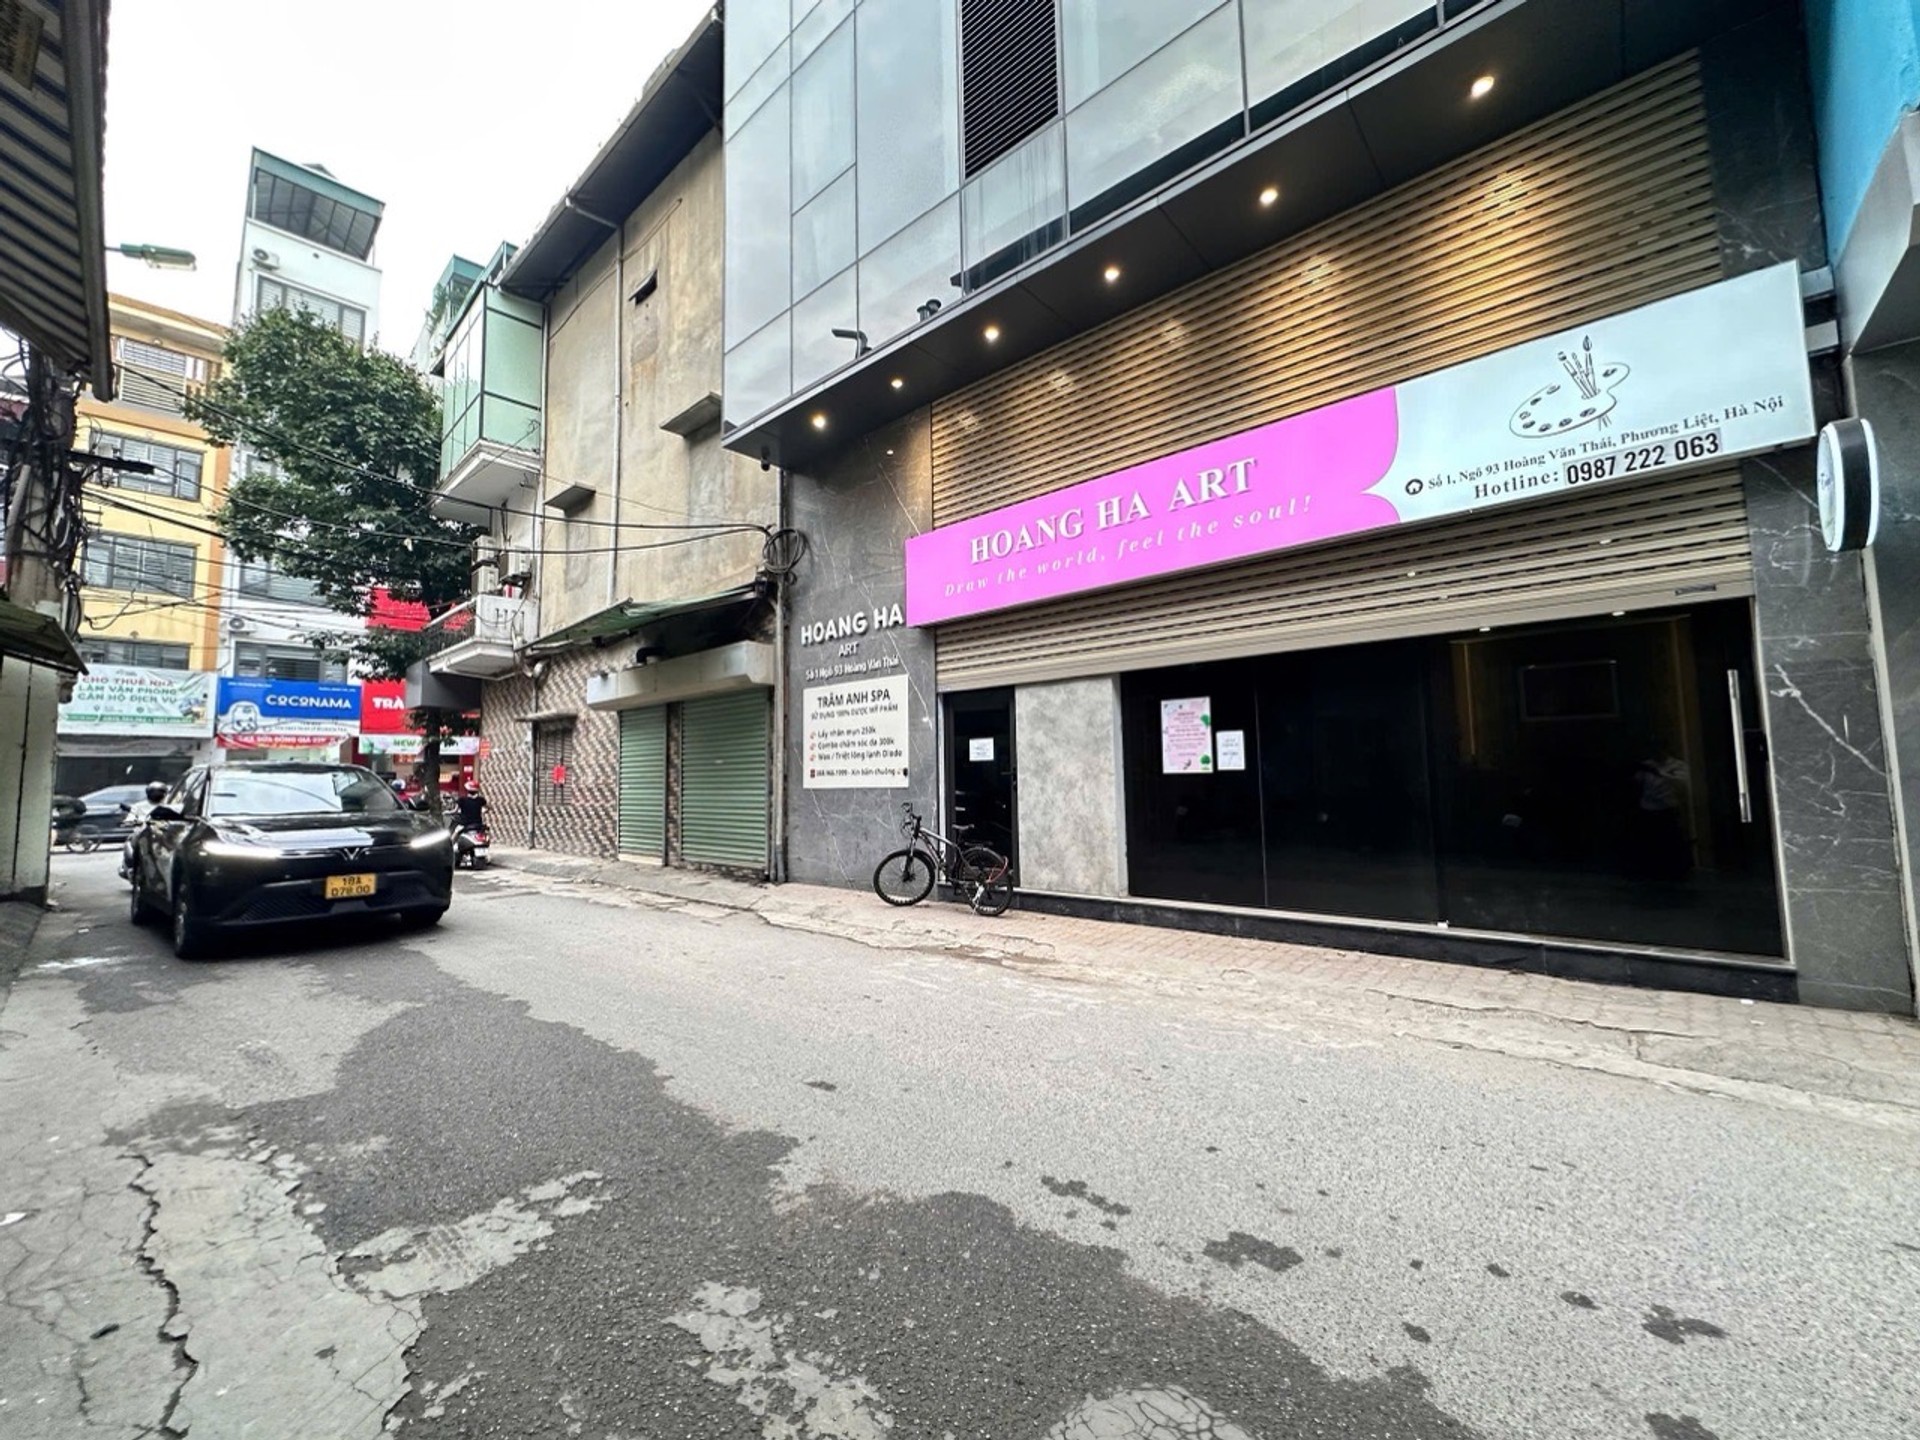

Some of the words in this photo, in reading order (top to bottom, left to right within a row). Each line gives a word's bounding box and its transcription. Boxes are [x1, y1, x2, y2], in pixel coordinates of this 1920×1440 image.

[1428, 473, 1443, 489] Số
[1446, 474, 1457, 485] 1,
[1459, 466, 1483, 482] Ngõ
[1485, 463, 1500, 475] 93
[1504, 451, 1546, 471] Hoàng
[1548, 444, 1576, 460] Văn
[1579, 436, 1617, 453] Thái,
[1621, 422, 1679, 444] Phương
[1683, 412, 1720, 430] Liệt,
[1724, 403, 1749, 420] Hà
[1753, 395, 1784, 414] Nội
[1474, 470, 1559, 499] Hotline:
[1567, 455, 1617, 485] 0987
[1624, 445, 1666, 472] 222
[1674, 432, 1720, 461] 063
[969, 506, 1084, 564] HOANG
[1096, 491, 1152, 531] HA
[1166, 456, 1258, 512] ART
[944, 574, 989, 597] Draw
[996, 565, 1029, 586] the
[1036, 547, 1107, 576] world,
[1115, 530, 1164, 560] feel
[1176, 518, 1220, 542] the
[1232, 495, 1313, 530] soul!
[801, 611, 868, 646] HOANG
[874, 603, 904, 629] HA
[839, 641, 859, 657] ART
[834, 665, 843, 676] 93
[82, 676, 109, 684] CHO
[266, 694, 352, 709] COCONAMA
[372, 695, 405, 710] TRÀ
[846, 691, 869, 704] ANH
[870, 688, 891, 702] SPA
